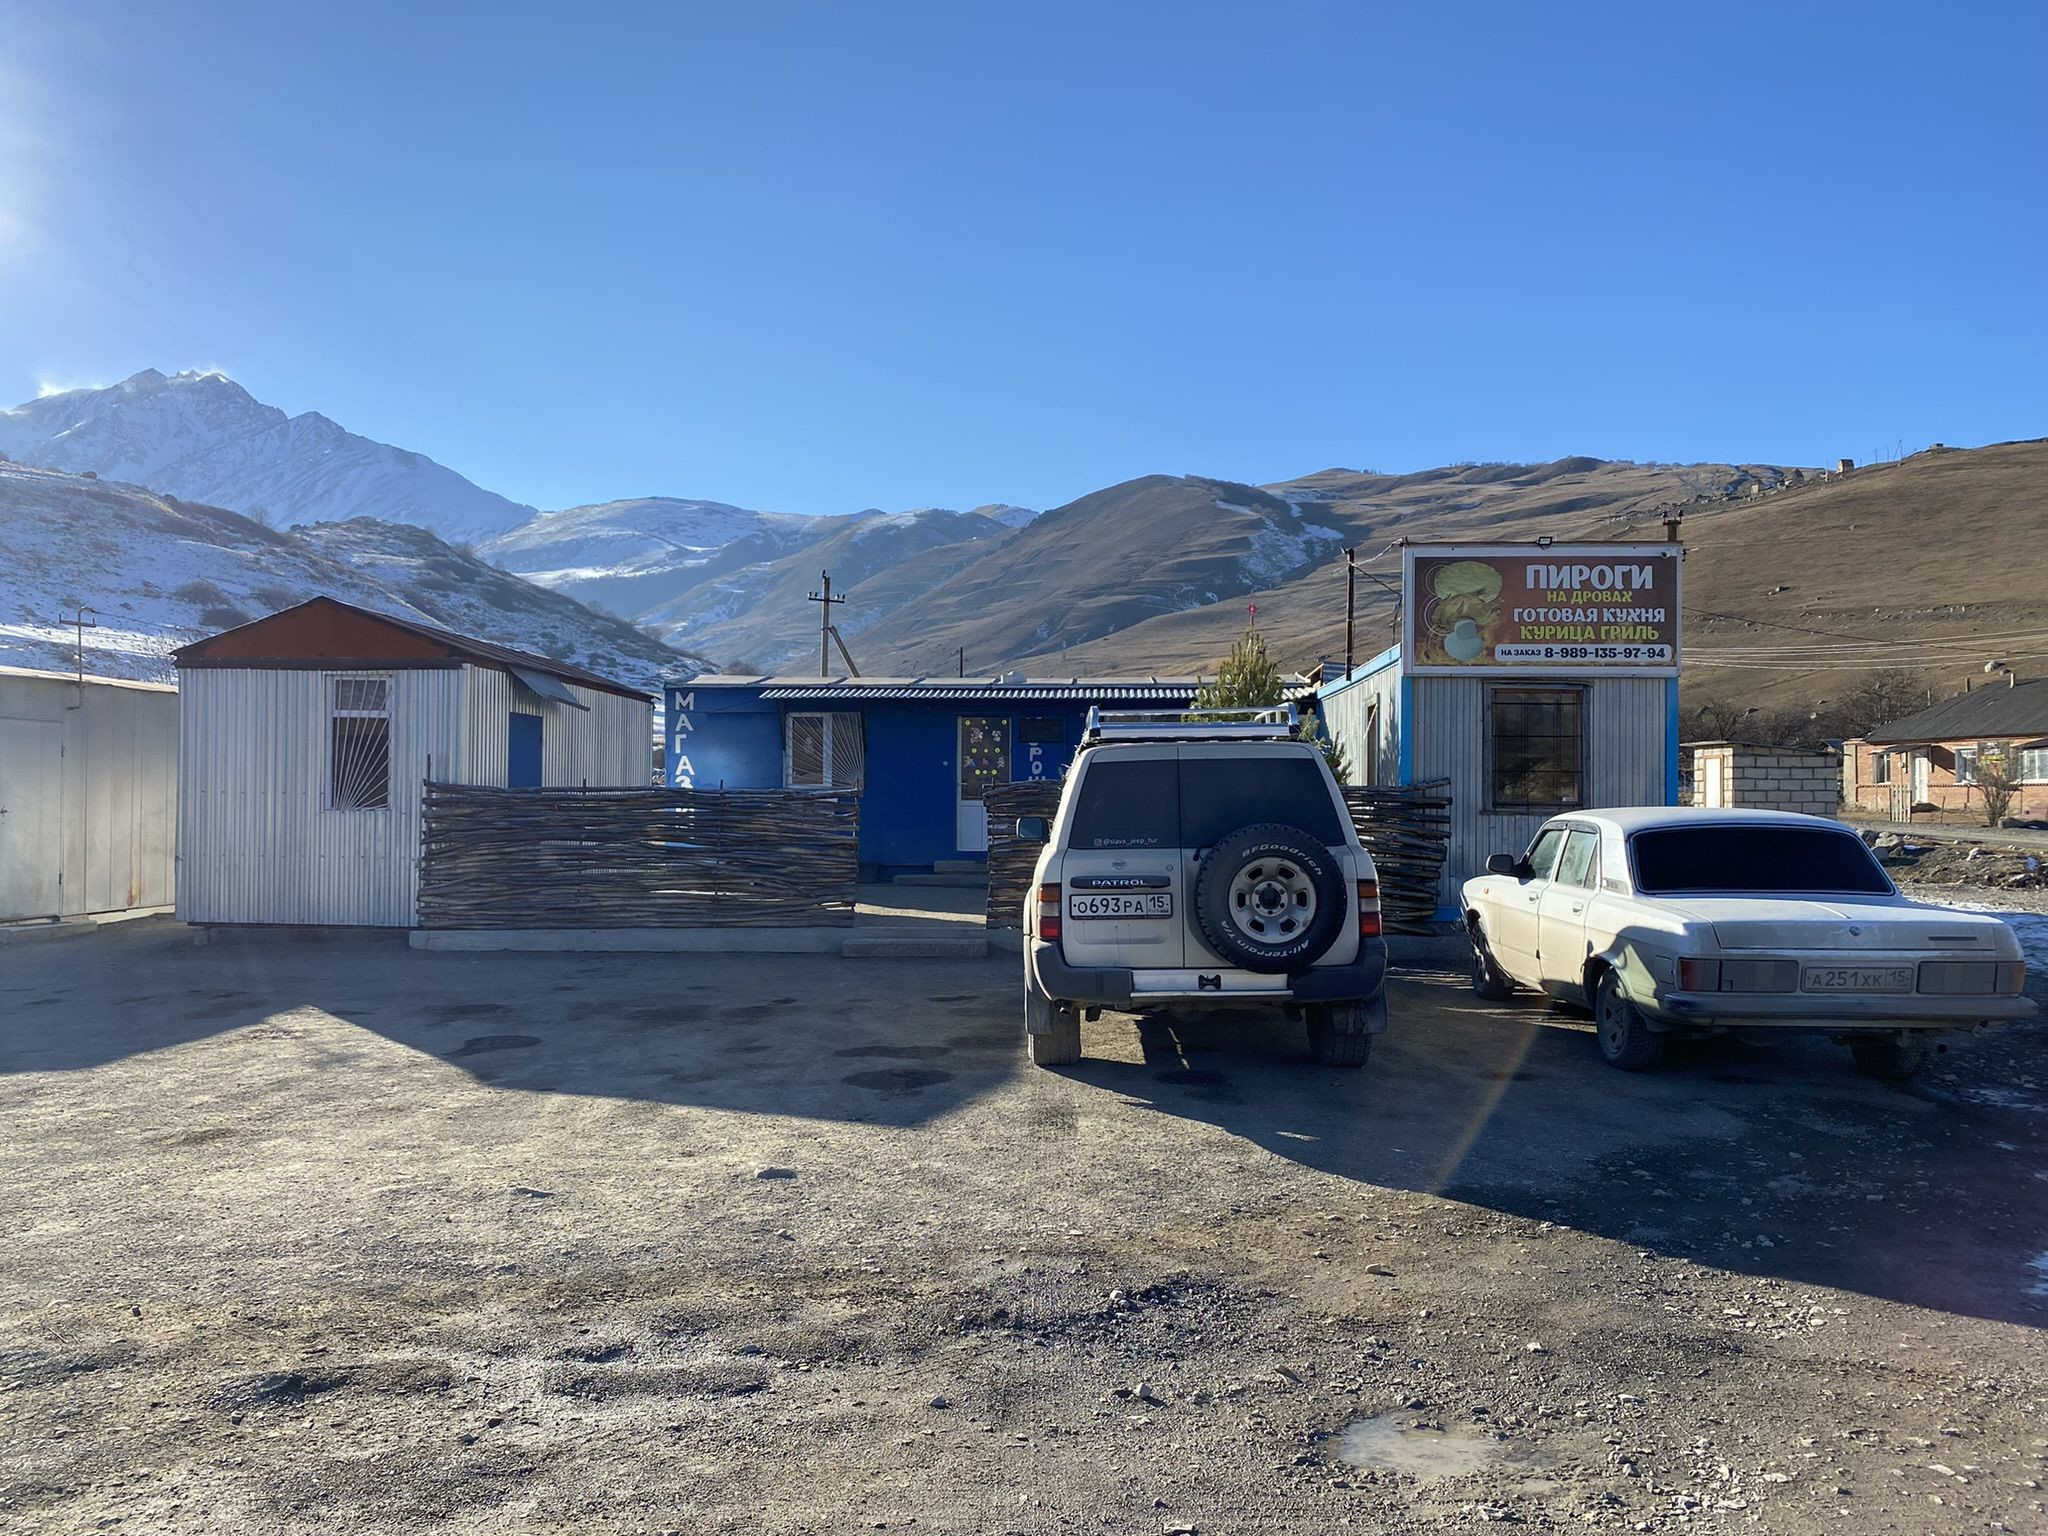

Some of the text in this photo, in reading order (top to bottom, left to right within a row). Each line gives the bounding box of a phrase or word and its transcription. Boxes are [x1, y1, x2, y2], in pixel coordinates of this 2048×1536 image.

[1526, 564, 1653, 589] ПИРОГИ
[1547, 590, 1633, 604] НА ДРОВАХ
[1513, 608, 1665, 622] ГОТОВАЯ КУХНЯ
[1520, 625, 1660, 642] КУРИЦА ГРИЛЬ
[1544, 647, 1666, 659] 8-989-135-97-94
[1241, 843, 1322, 875] BFGoodrich
[1077, 896, 1165, 914] О693РА 15
[1811, 970, 1906, 987] А251ХК 15
